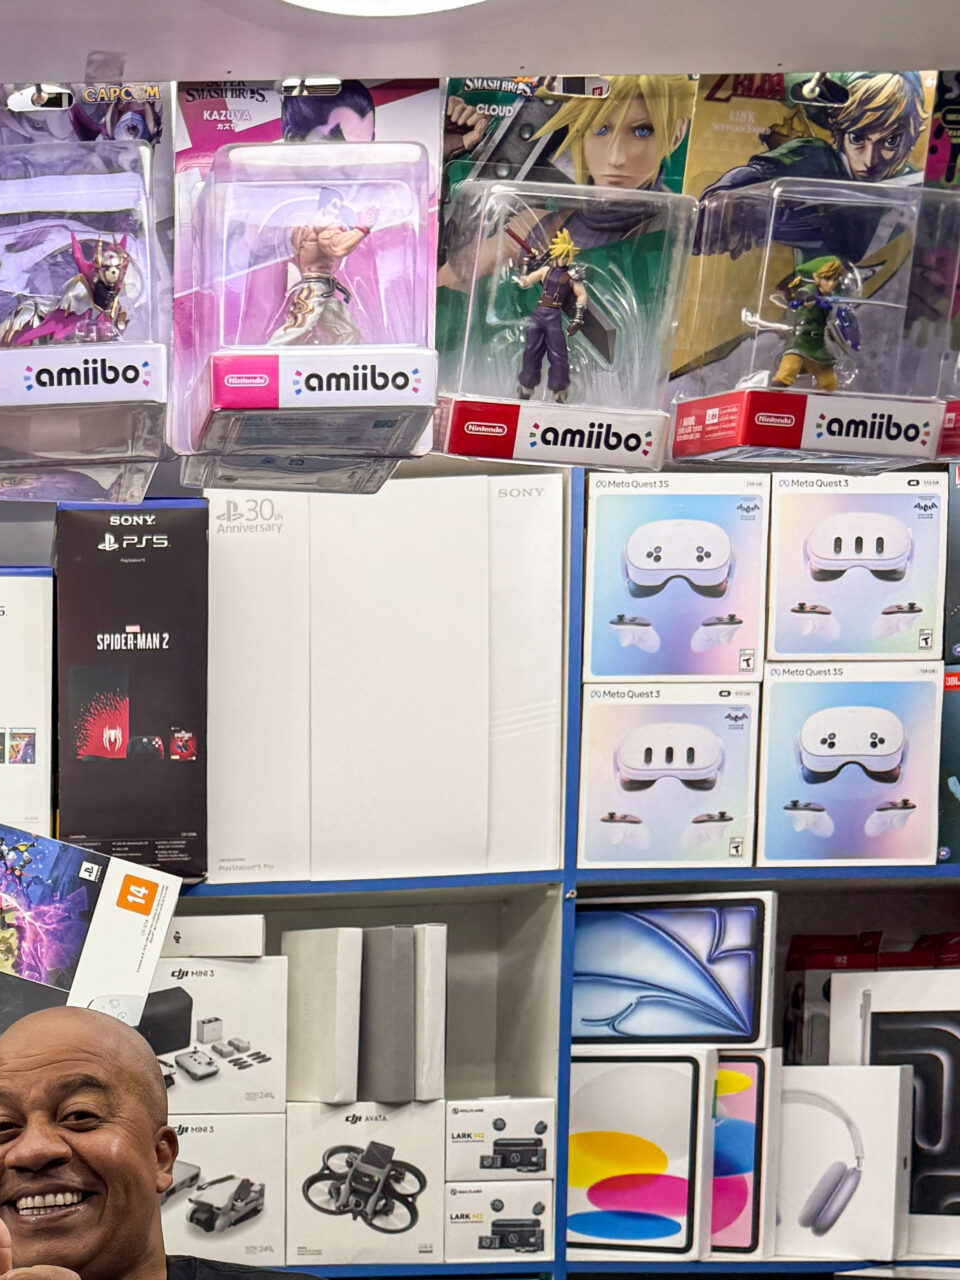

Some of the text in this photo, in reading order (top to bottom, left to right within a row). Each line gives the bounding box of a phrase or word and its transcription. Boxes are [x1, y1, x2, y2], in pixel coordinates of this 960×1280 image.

[203, 109, 252, 121] KAZUYA
[476, 103, 514, 117] CLOUD
[35, 358, 140, 388] amiibo
[304, 364, 410, 392] amiibo
[228, 376, 266, 385] Nintendo
[758, 416, 793, 425] Nintendo
[467, 424, 505, 434] Nintendo
[826, 413, 921, 442] amiibo
[540, 424, 642, 452] amiibo
[607, 480, 670, 489] Meta Quest 3S
[791, 479, 849, 488] Meta Quest 3
[497, 488, 545, 498] SONY
[110, 515, 156, 526] SONY
[216, 522, 284, 535] Anniversary
[122, 536, 171, 548] PS5
[96, 632, 170, 651] SPIDER-MAN 2
[782, 669, 843, 678] Meta Quest 3S
[603, 690, 661, 699] Meta Quest 3
[127, 886, 149, 905] 14
